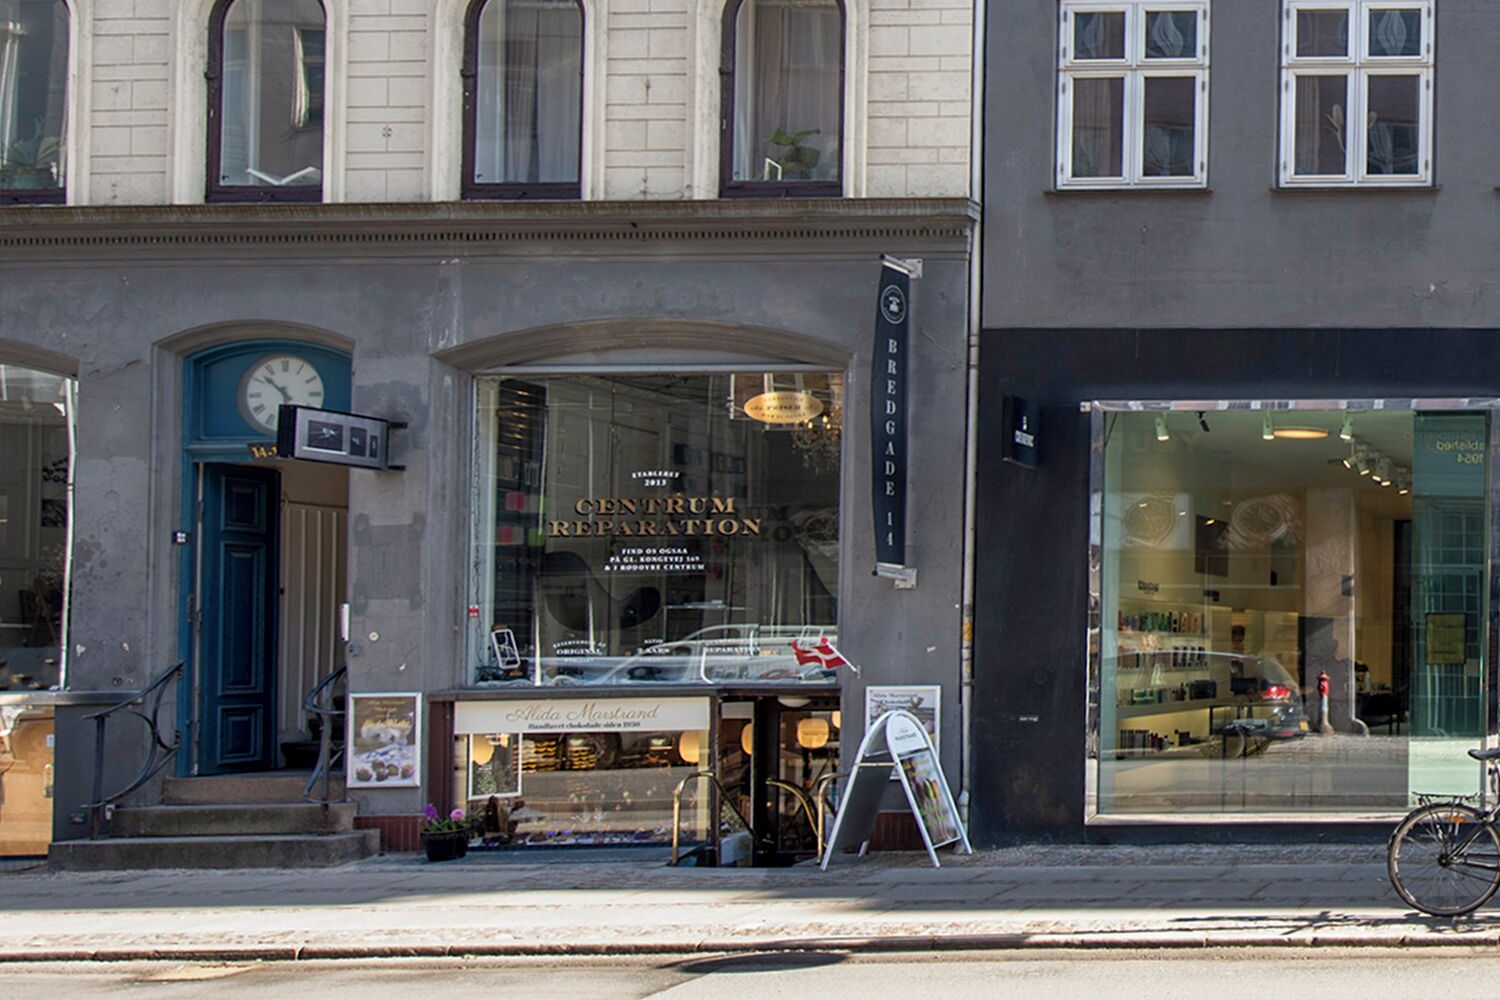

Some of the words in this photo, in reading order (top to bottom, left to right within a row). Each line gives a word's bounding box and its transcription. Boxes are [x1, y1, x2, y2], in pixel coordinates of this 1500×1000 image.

[885, 339, 898, 496] BREDGADE
[632, 470, 680, 479] ETABLERET
[574, 497, 736, 515] CENTRUM
[549, 518, 762, 537] REPARATION
[885, 511, 894, 546] 14
[609, 555, 621, 563] PÅ
[505, 704, 561, 722] Alida
[566, 702, 662, 722] Marstrand
